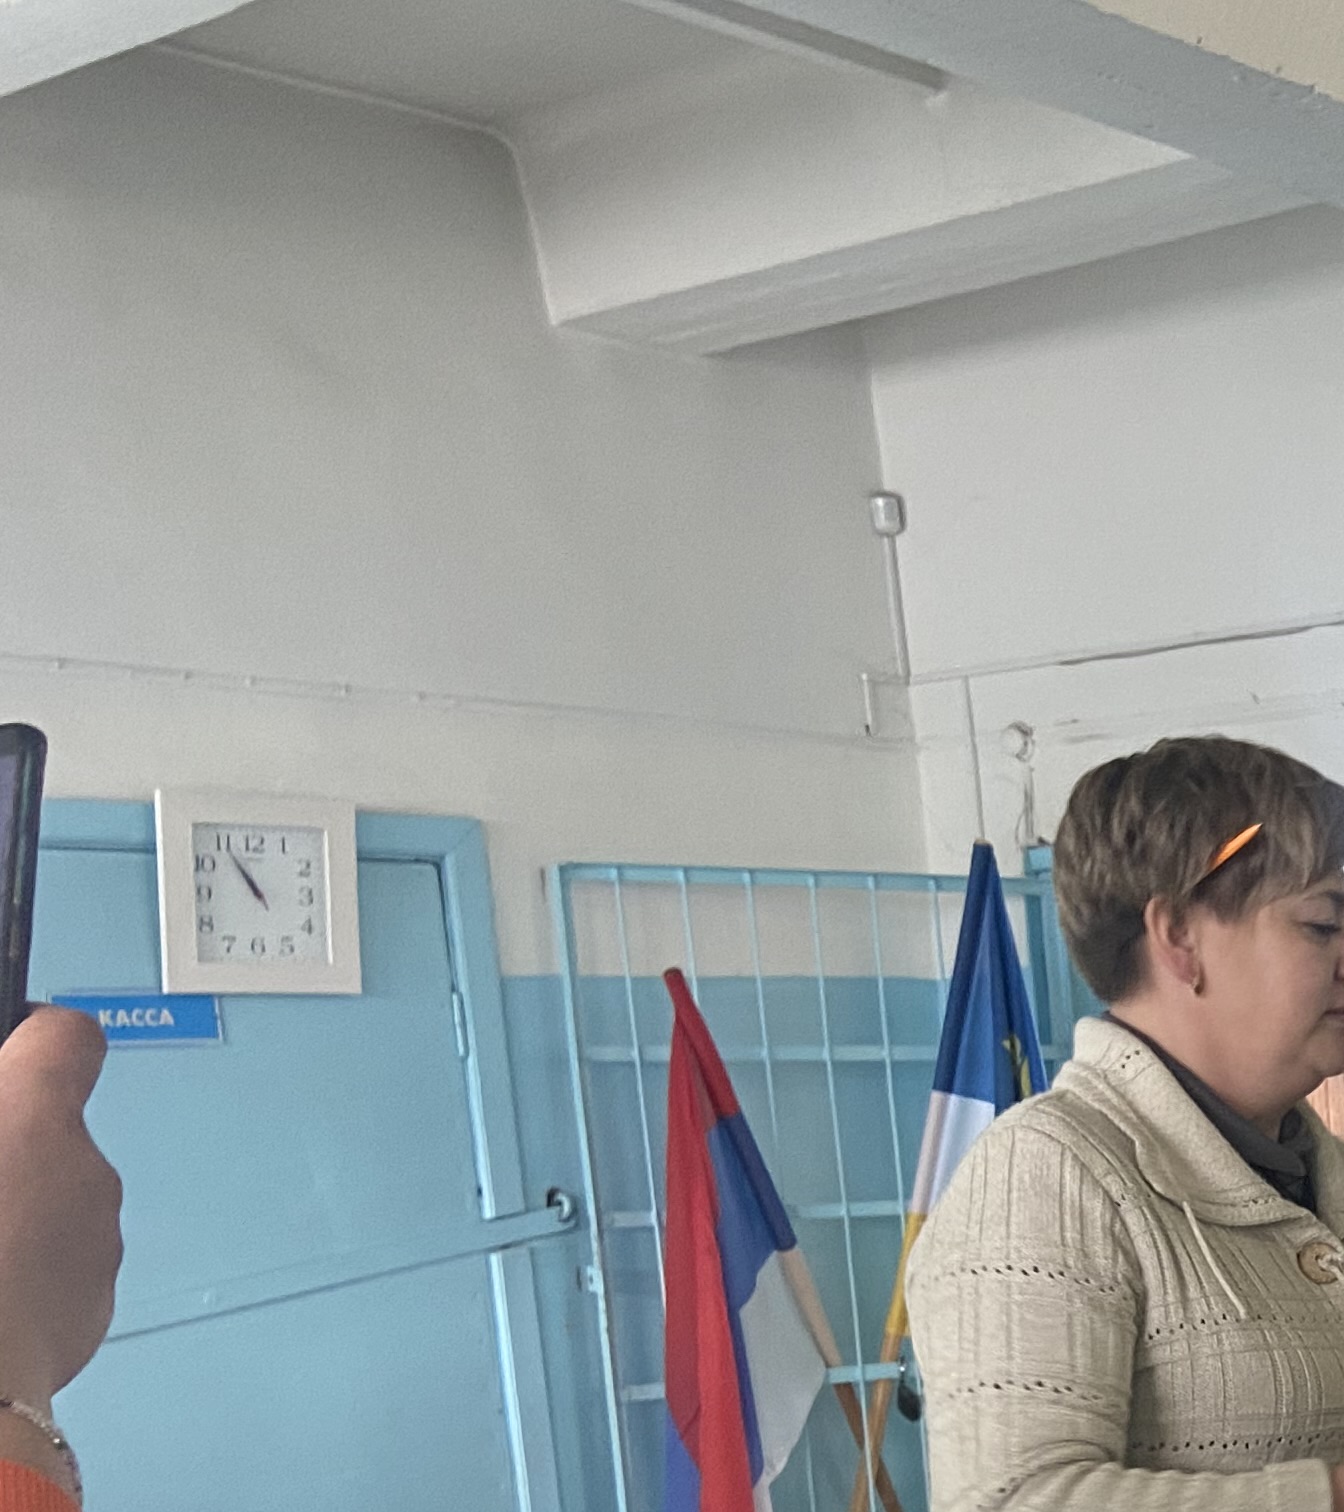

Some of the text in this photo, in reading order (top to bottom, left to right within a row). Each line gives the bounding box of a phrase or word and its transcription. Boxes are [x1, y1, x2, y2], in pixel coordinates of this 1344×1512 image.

[216, 832, 231, 852] 11
[245, 834, 265, 854] 12
[195, 854, 216, 873] 10
[299, 859, 311, 878] 2
[197, 885, 212, 903] 9
[300, 886, 314, 906] 3
[199, 916, 214, 933] 8
[301, 918, 313, 935] 4
[222, 935, 236, 953] 7
[251, 937, 266, 956] 6
[279, 936, 295, 957] 5
[98, 1008, 174, 1027] КАССА
